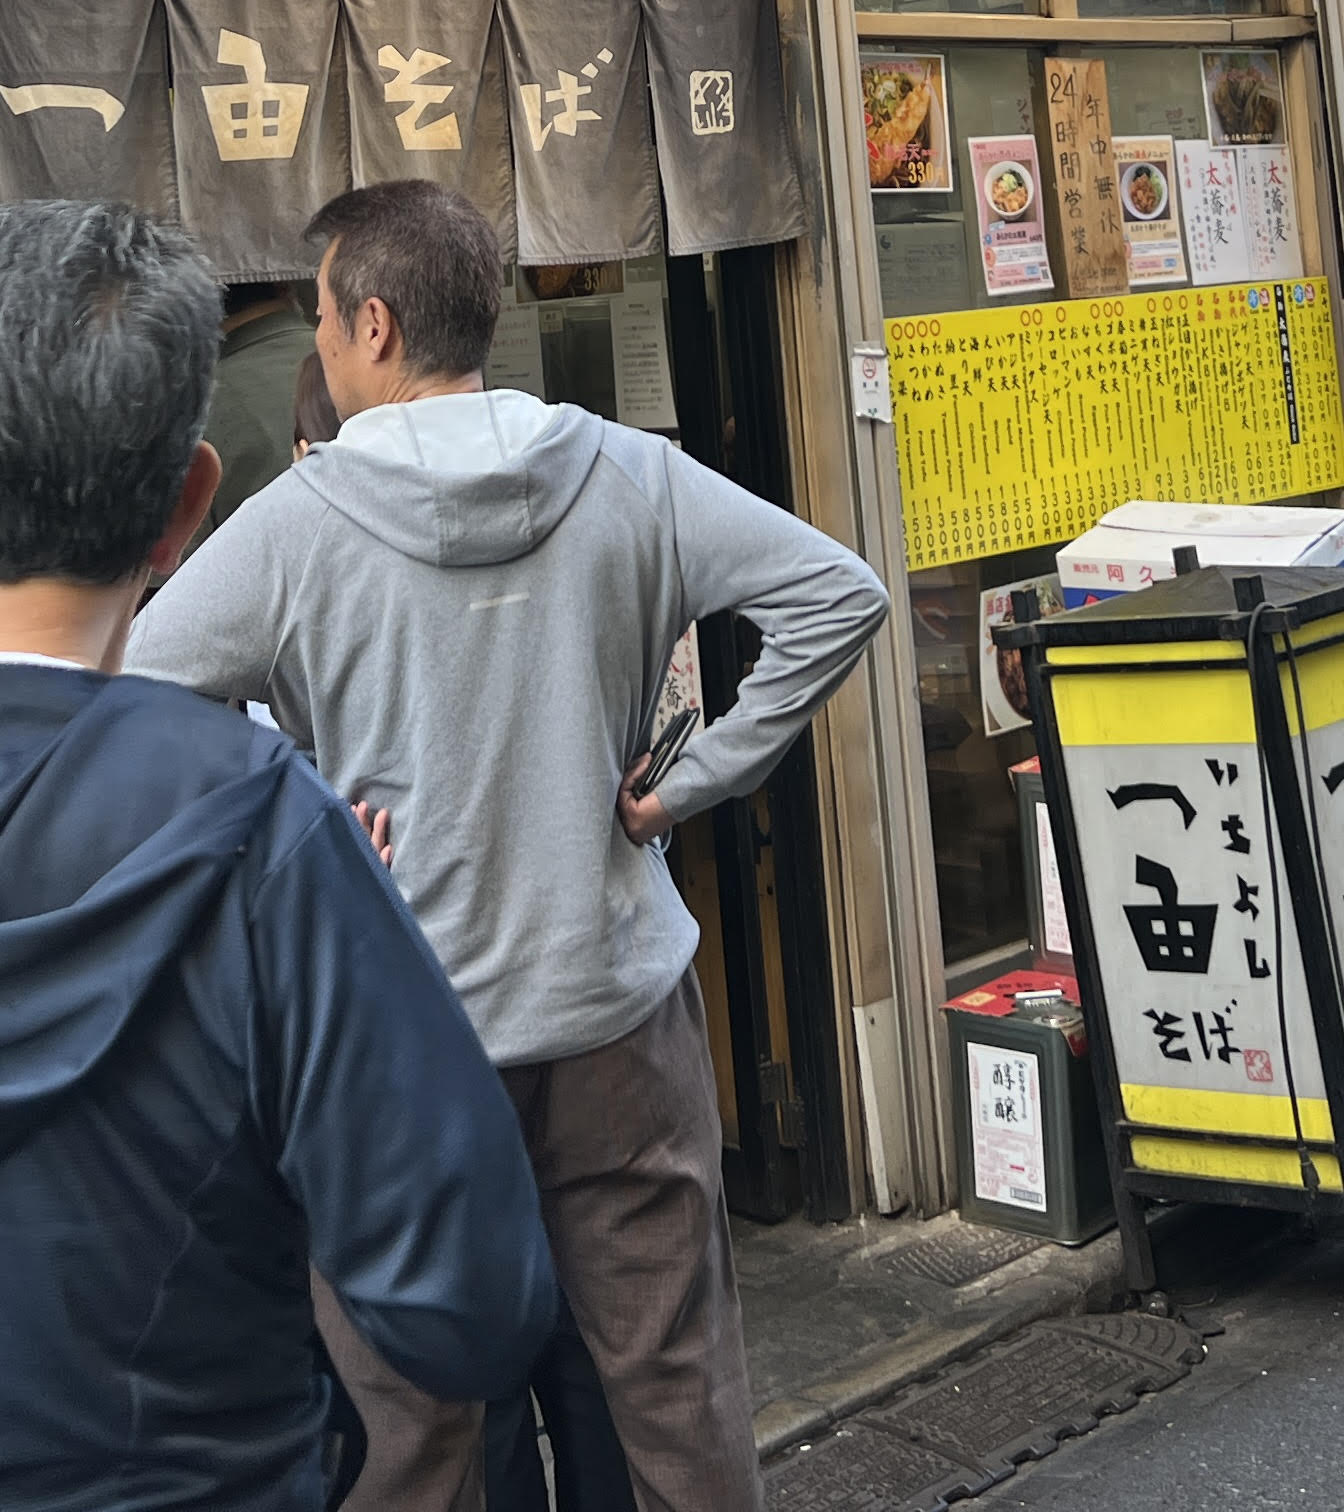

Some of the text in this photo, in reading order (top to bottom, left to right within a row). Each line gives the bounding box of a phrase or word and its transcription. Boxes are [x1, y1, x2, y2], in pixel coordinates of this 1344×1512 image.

[1050, 72, 1089, 255] 24時間営業
[1086, 94, 1120, 234] 年中無休
[1106, 564, 1176, 583] 阿久
